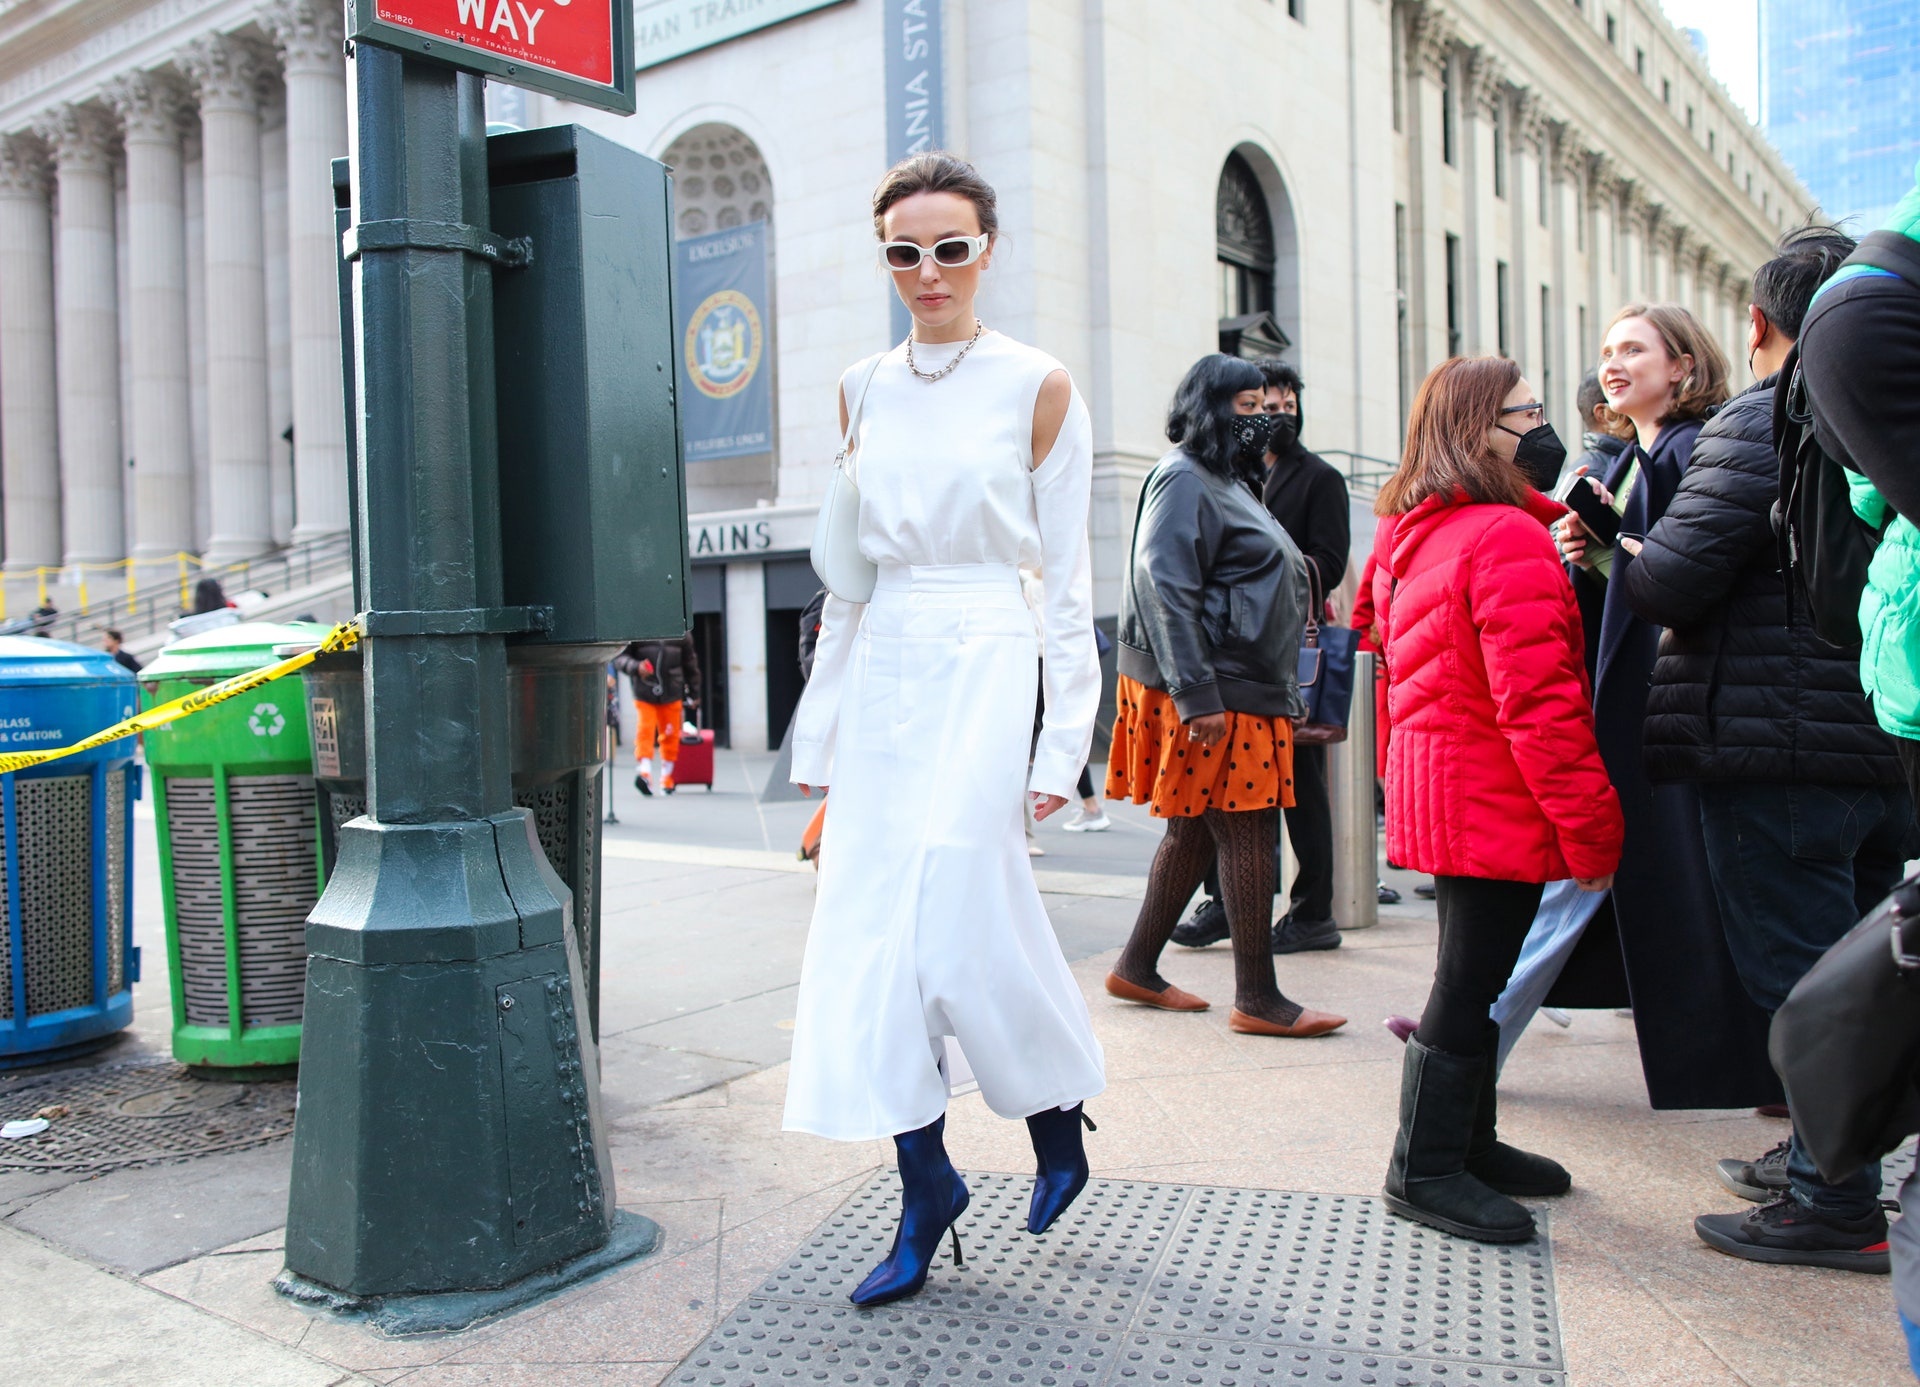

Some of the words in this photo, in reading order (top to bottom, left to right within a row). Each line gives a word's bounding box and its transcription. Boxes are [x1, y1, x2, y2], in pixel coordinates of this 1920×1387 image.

[380, 10, 414, 25] SR-1820
[456, 0, 545, 45] WAY
[485, 40, 557, 66] TRANSPORTATION
[12, 729, 63, 742] CARTONS
